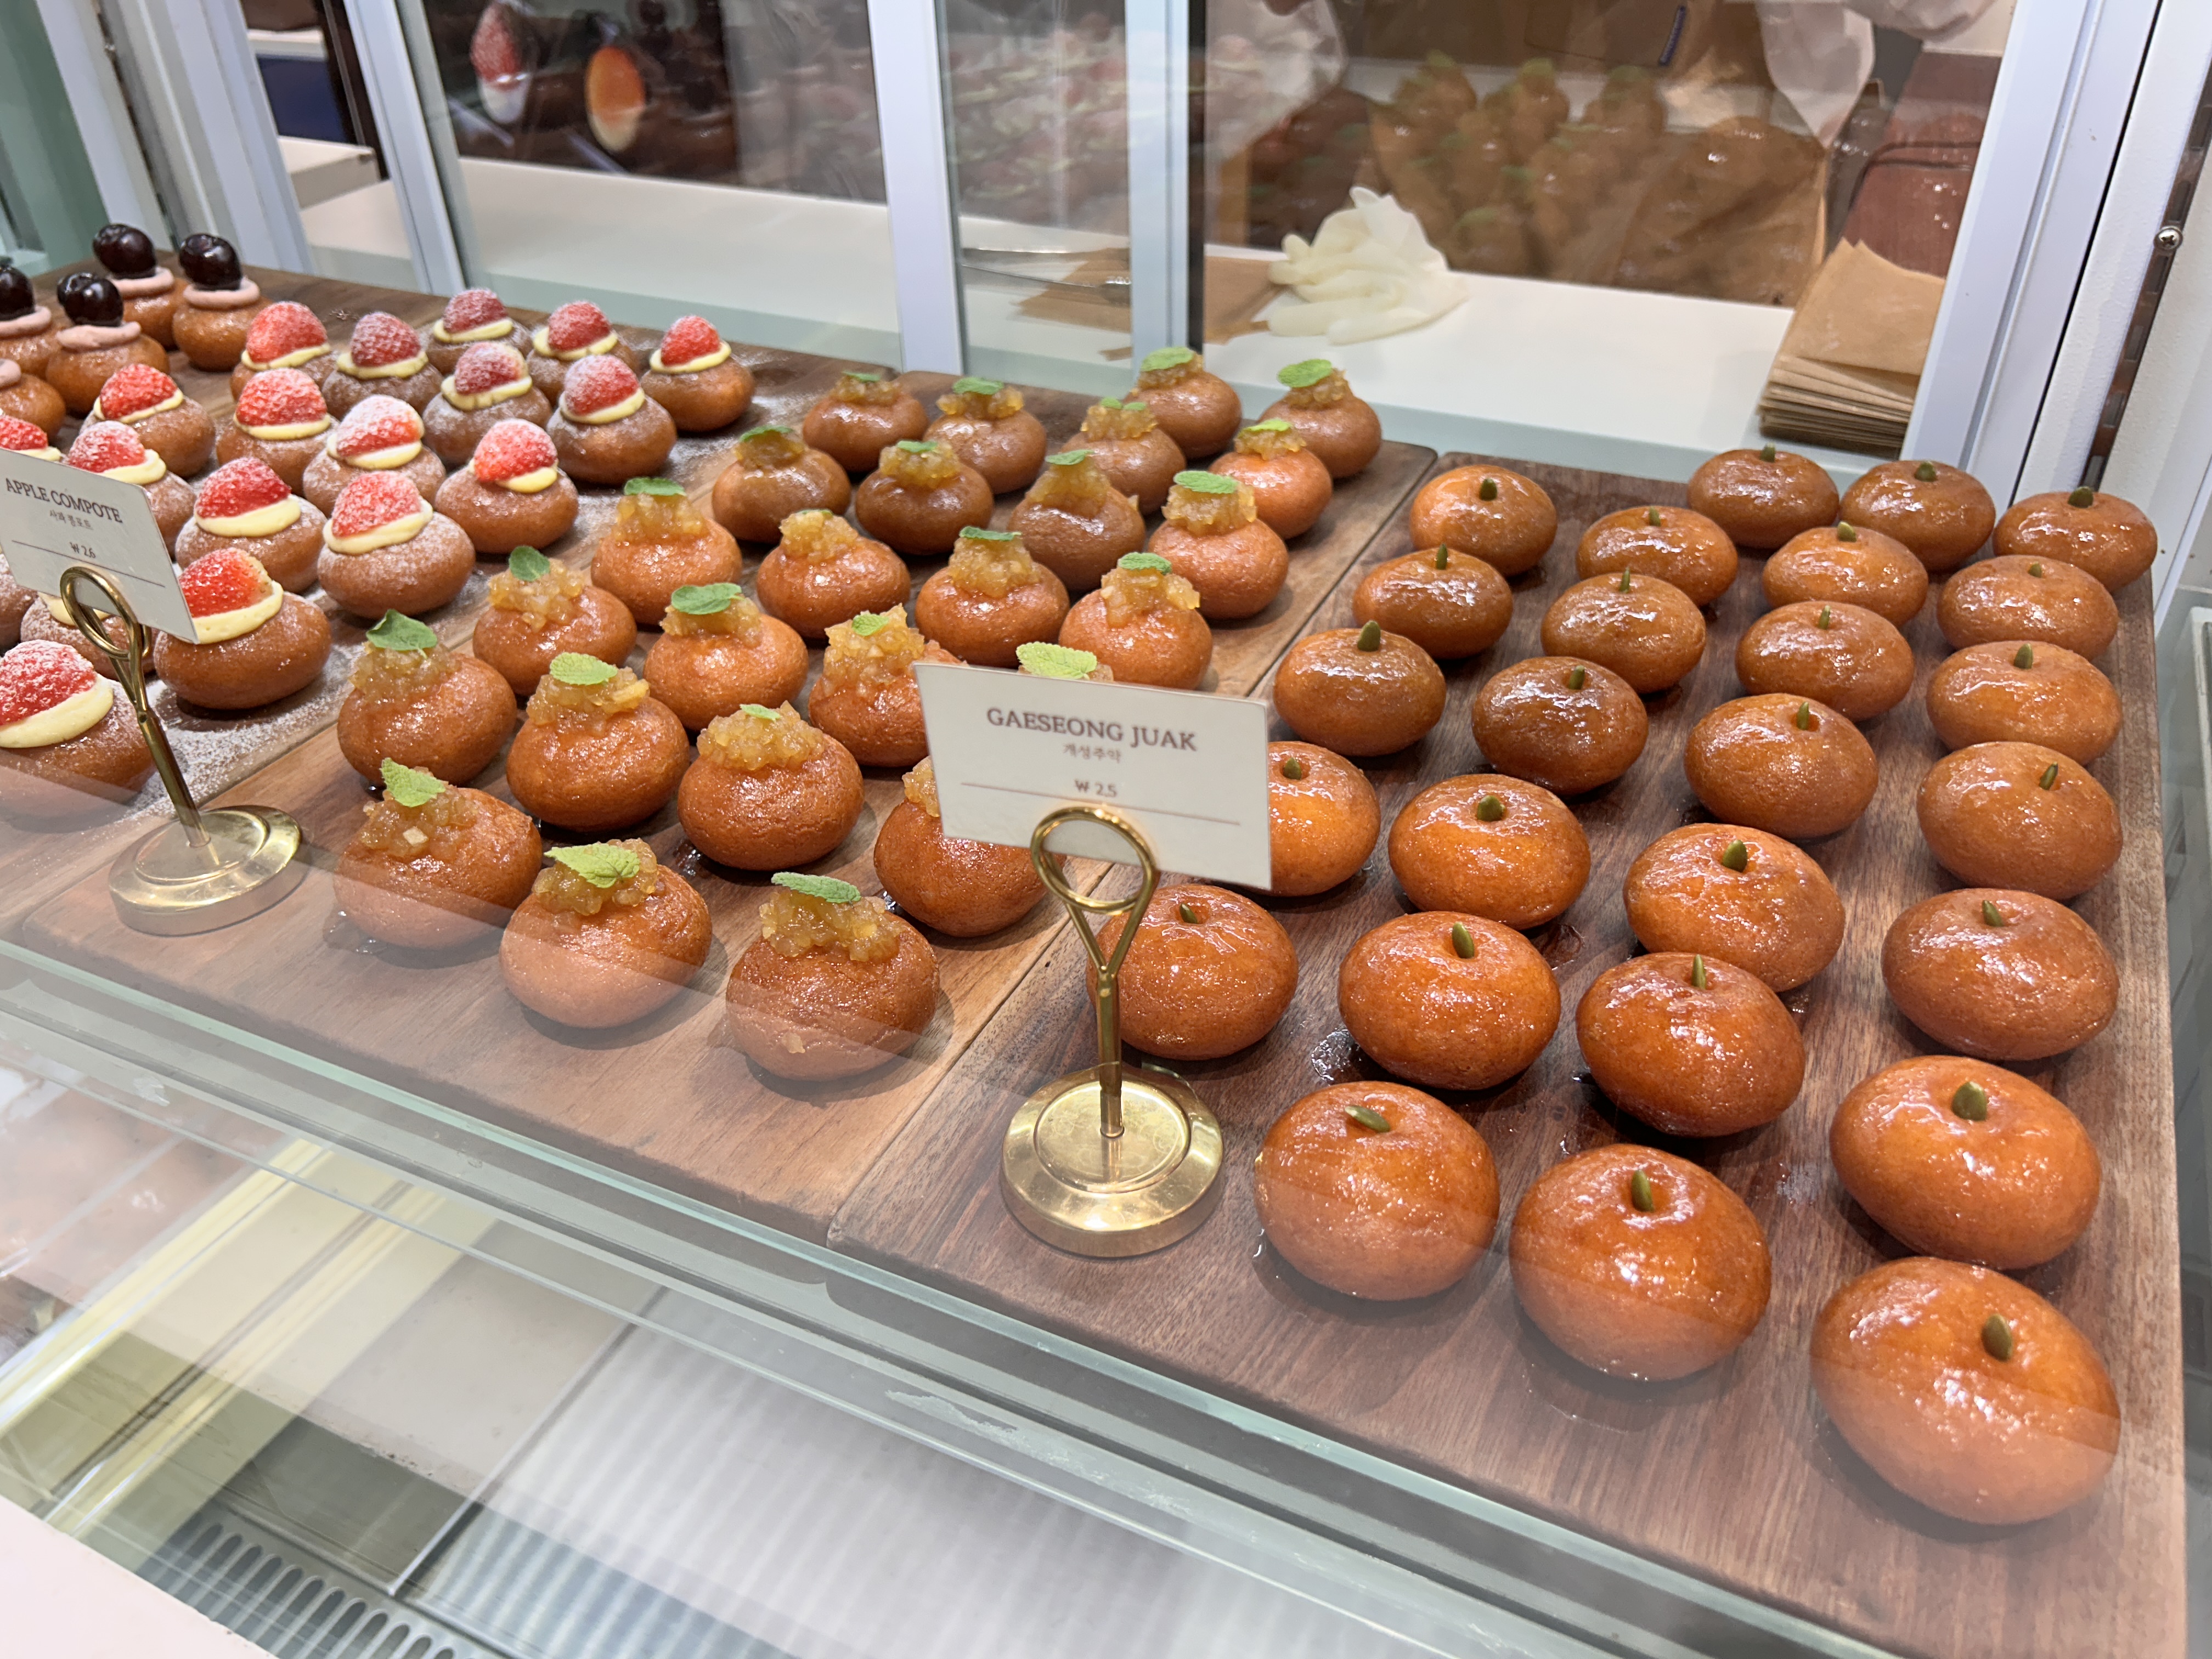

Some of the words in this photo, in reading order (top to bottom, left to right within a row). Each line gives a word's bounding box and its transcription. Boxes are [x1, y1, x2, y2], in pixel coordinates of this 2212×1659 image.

[5, 478, 50, 502] APPLE
[50, 490, 123, 523] COMPOTE
[988, 708, 1124, 742] GAESEONG
[1130, 725, 1197, 752] JUAK
